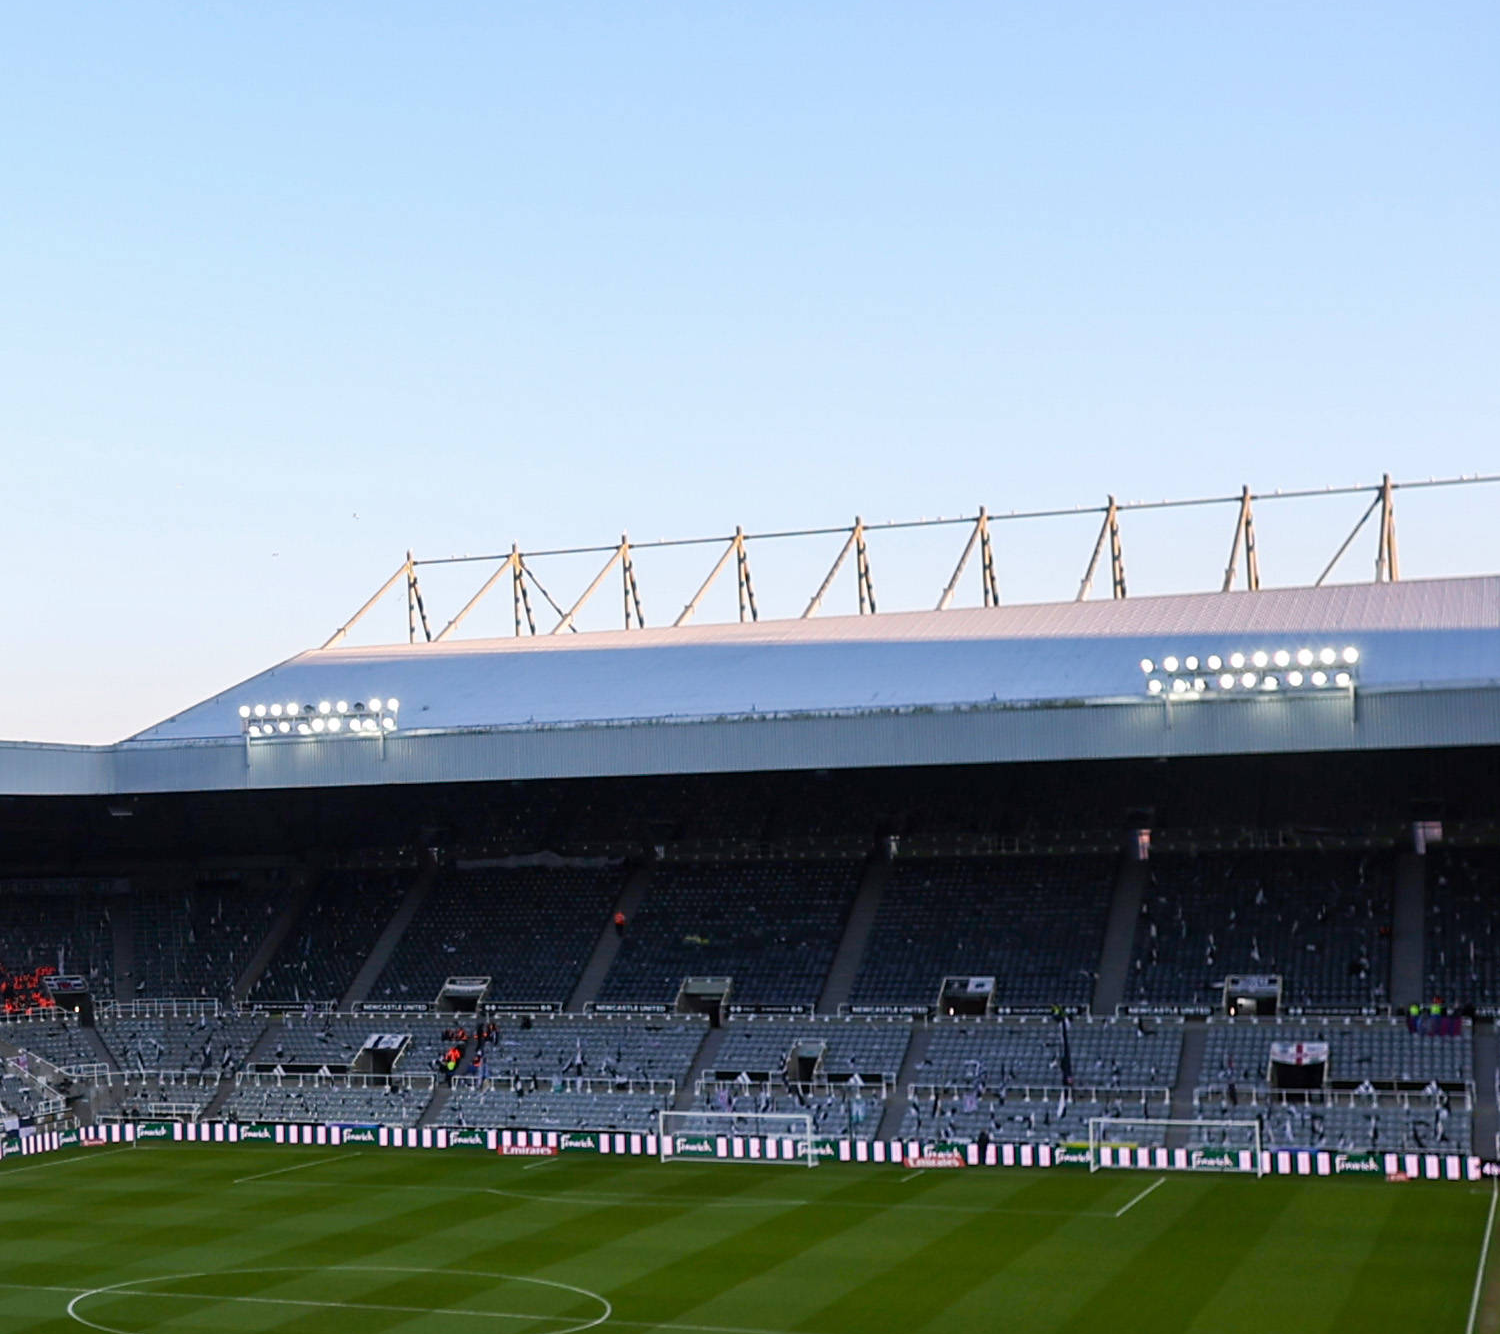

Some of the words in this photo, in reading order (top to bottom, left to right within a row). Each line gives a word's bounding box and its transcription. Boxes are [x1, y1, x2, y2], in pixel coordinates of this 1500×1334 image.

[363, 1003, 402, 1012] NEWCASTLE
[403, 1004, 428, 1012] UNITED
[596, 1004, 639, 1012] NEWCASTLE
[137, 1124, 167, 1139] Fenwick
[240, 1126, 271, 1140] Fenwick
[343, 1128, 375, 1143] Fenwick
[450, 1131, 483, 1146] Fenwick
[561, 1134, 595, 1150] Fenwick
[676, 1138, 712, 1154] Fenwick
[502, 1145, 552, 1155] Emirates
[1335, 1155, 1380, 1172] Fenwick
